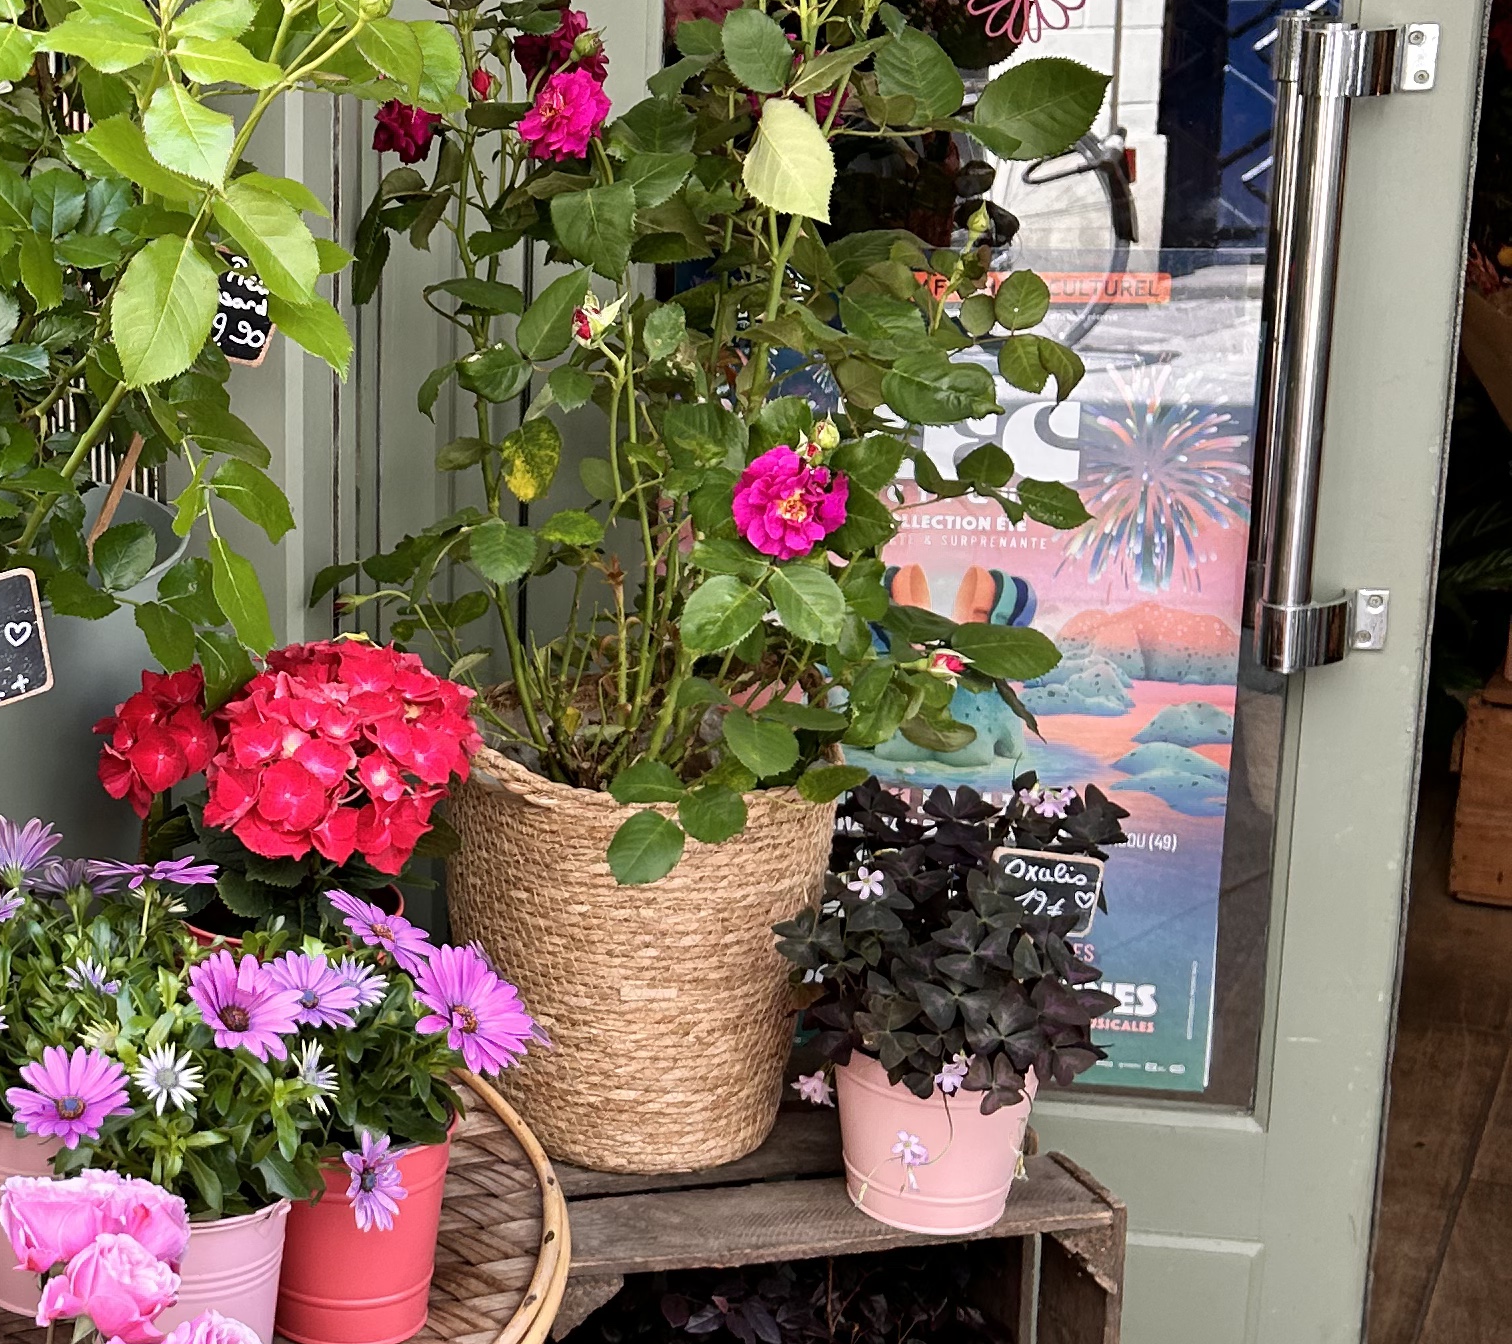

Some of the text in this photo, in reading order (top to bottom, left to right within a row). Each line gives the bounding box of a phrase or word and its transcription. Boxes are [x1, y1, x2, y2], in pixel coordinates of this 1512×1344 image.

[1050, 279, 1160, 297] CULTUREL
[894, 513, 991, 531] LLECTION
[941, 534, 1048, 550] SURPRENANTE
[1148, 832, 1178, 854] (49)
[1004, 858, 1088, 887] Oxalis
